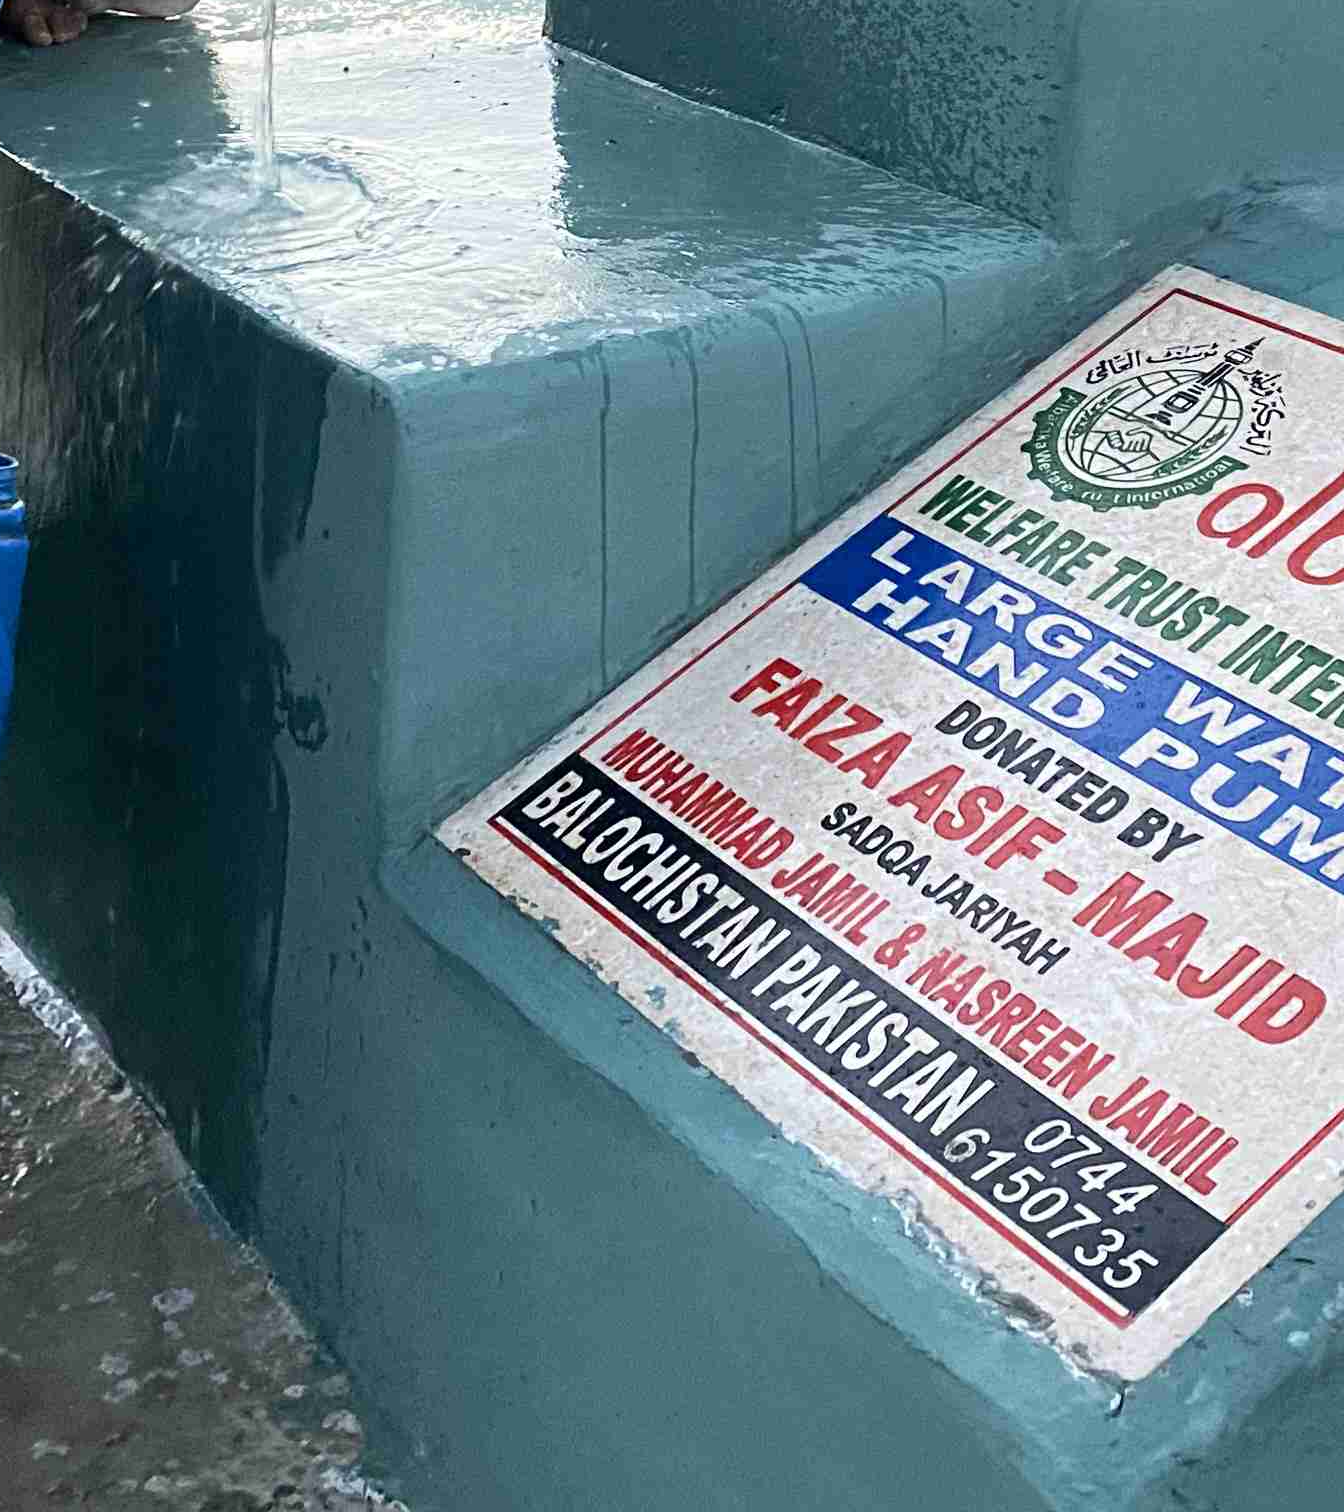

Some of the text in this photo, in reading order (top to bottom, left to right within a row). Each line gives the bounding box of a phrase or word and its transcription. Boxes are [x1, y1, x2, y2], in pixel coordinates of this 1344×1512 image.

[868, 530, 1156, 693] LARGE
[918, 474, 1096, 587] WELFARE
[1085, 555, 1250, 652] TRUST
[851, 578, 1106, 730] HAND
[729, 657, 913, 789] FAIZA
[887, 765, 1066, 870] ASIF
[1072, 872, 1327, 1044] MAJID
[934, 699, 1204, 864] DONATED BY
[521, 771, 996, 1137] BALOCHISTAN PAKISTAN
[600, 728, 1239, 1196] MUHAMMAD JAMIL & NASREEN JAMIL
[820, 802, 1071, 976] SADQA JARIYAH
[943, 1128, 1159, 1289] 6150735
[1024, 1118, 1159, 1216] 0744
